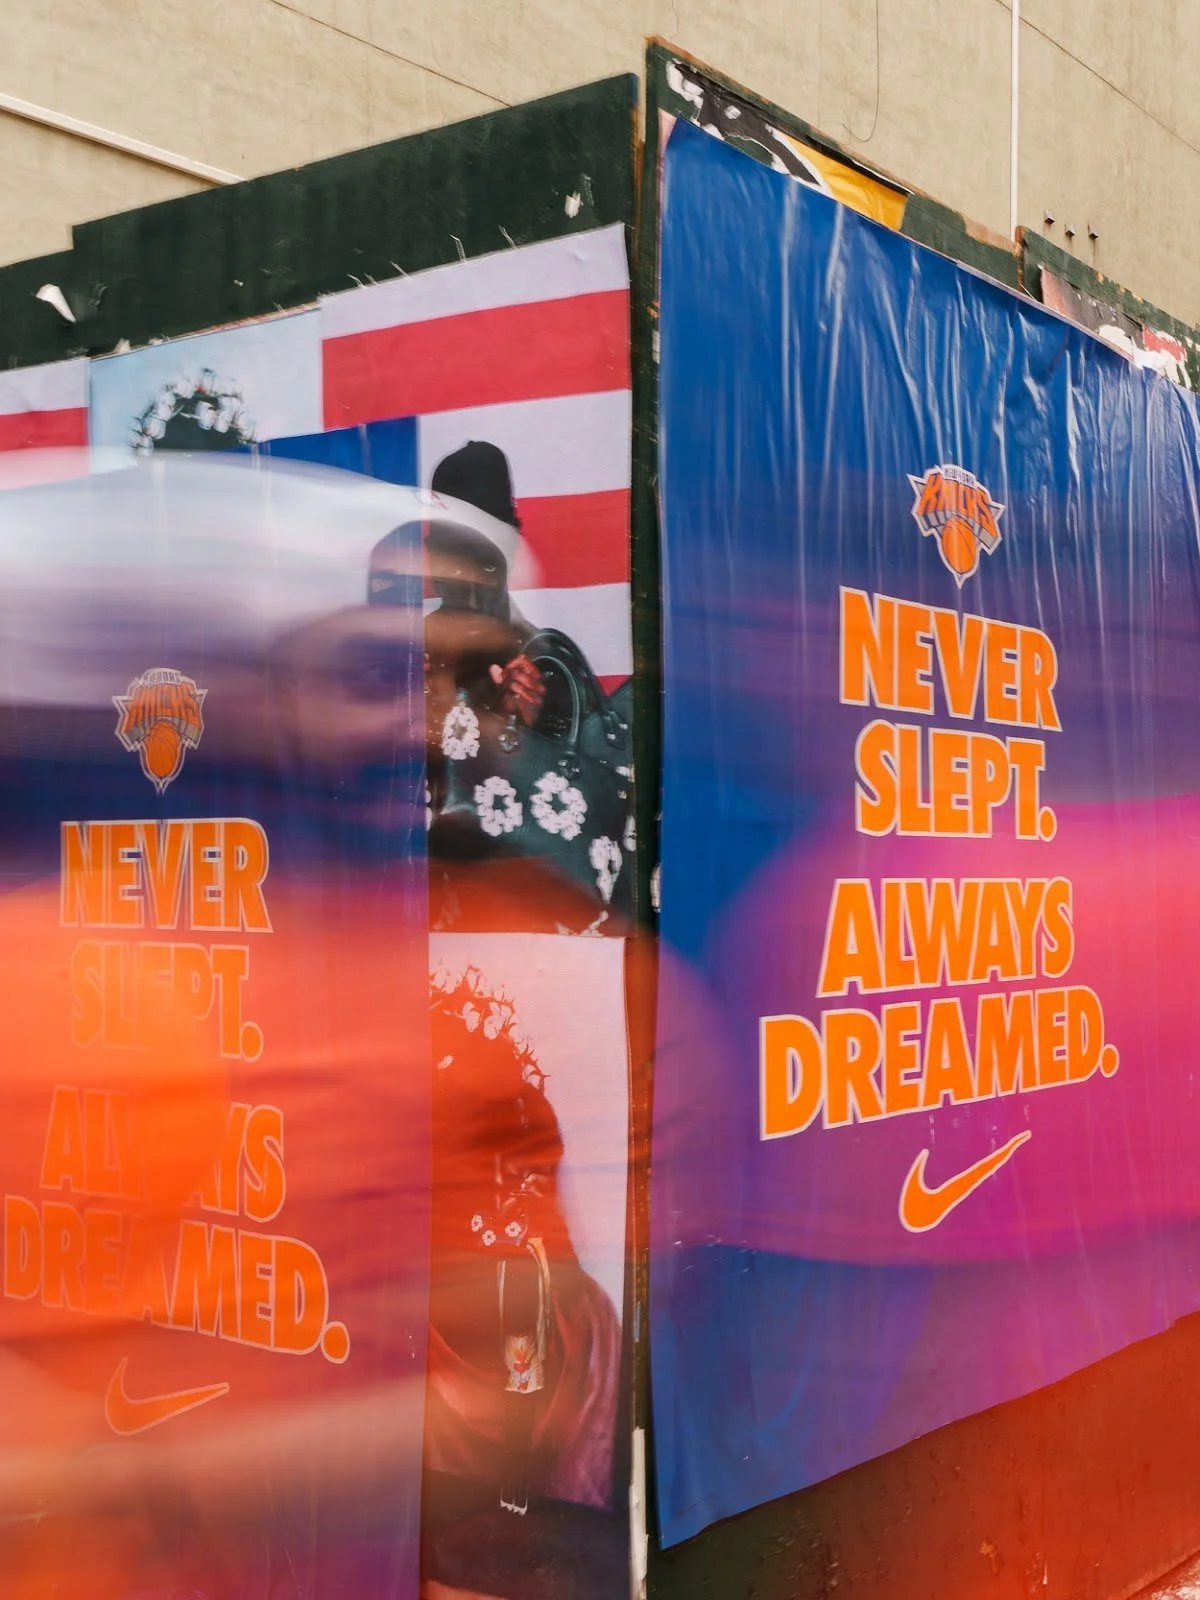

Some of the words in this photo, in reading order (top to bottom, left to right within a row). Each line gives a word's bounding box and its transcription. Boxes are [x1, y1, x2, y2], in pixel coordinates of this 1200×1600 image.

[917, 472, 998, 540] KNICKS
[839, 585, 1063, 732] NEVER
[855, 719, 1057, 842] SLEPT.
[60, 818, 274, 934] NEVER
[815, 875, 1074, 997] ALWAYS
[71, 939, 264, 1062] SLEPT.
[759, 984, 1120, 1141] DREAMED.
[4, 1194, 350, 1364] DREAMED.
